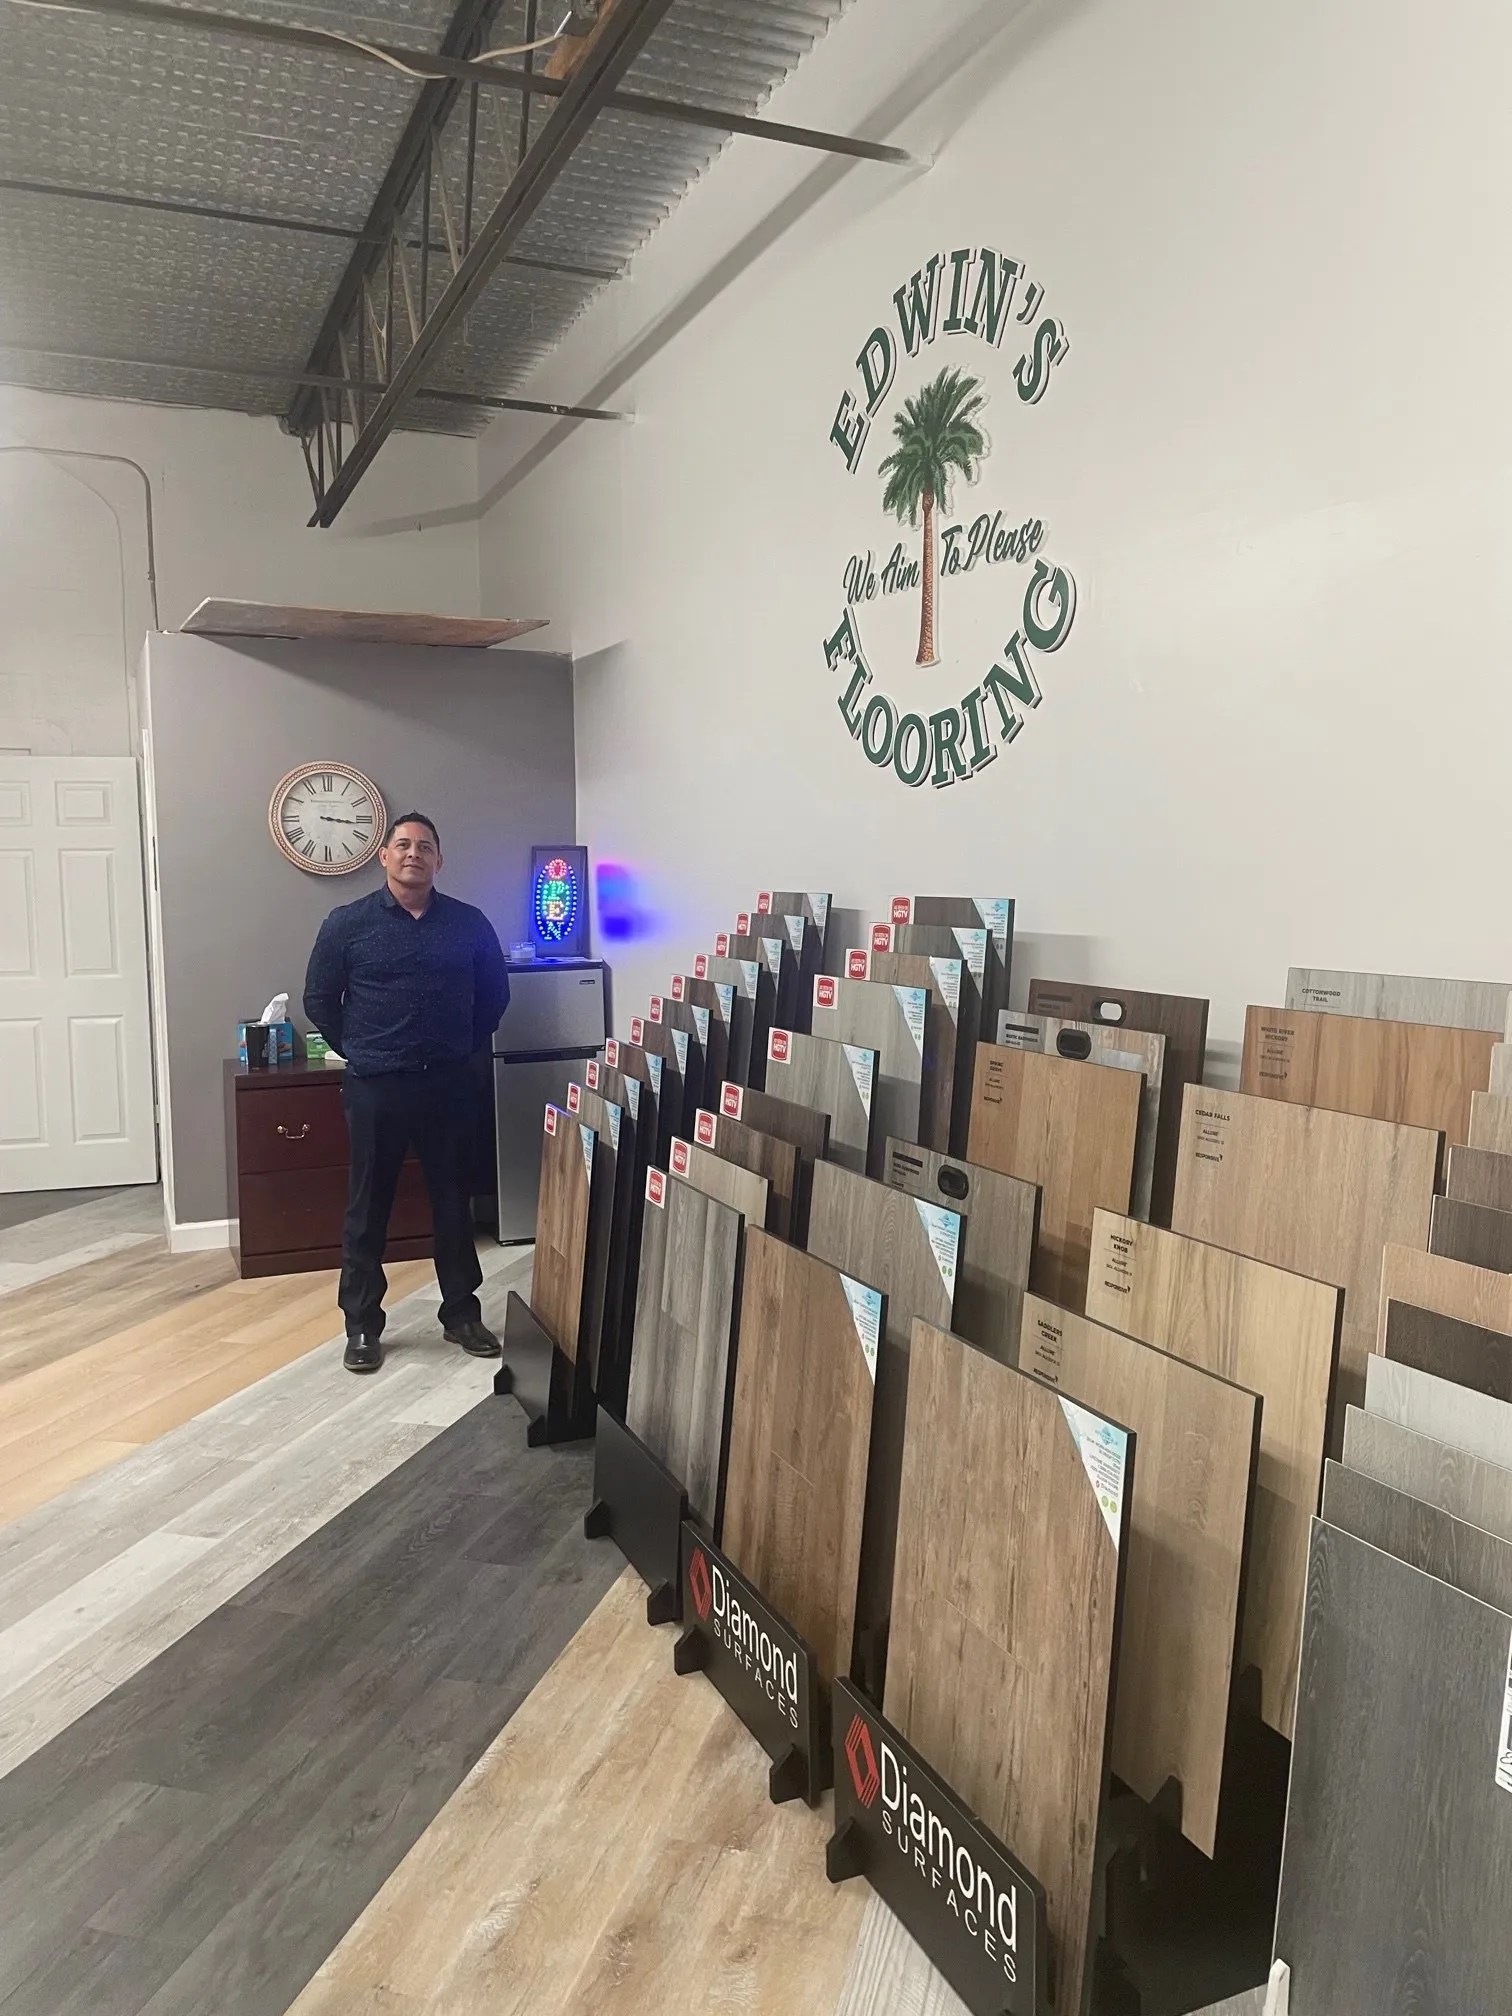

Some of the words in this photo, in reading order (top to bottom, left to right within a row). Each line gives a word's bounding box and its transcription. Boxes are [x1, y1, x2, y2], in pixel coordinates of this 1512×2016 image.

[829, 246, 1070, 474] EDWIN'S
[844, 556, 879, 606] We
[881, 543, 920, 590] Aim
[940, 524, 963, 578] To
[961, 510, 1046, 574] Please
[823, 557, 1077, 789] FLOORING
[543, 858, 567, 941] OPEN
[1301, 988, 1341, 997] COTTONWOOD
[712, 1564, 799, 1706] Diamond
[713, 1617, 800, 1729] SURFACES
[880, 1741, 1018, 1953] Diamond
[882, 1809, 1018, 1983] SURFACES
